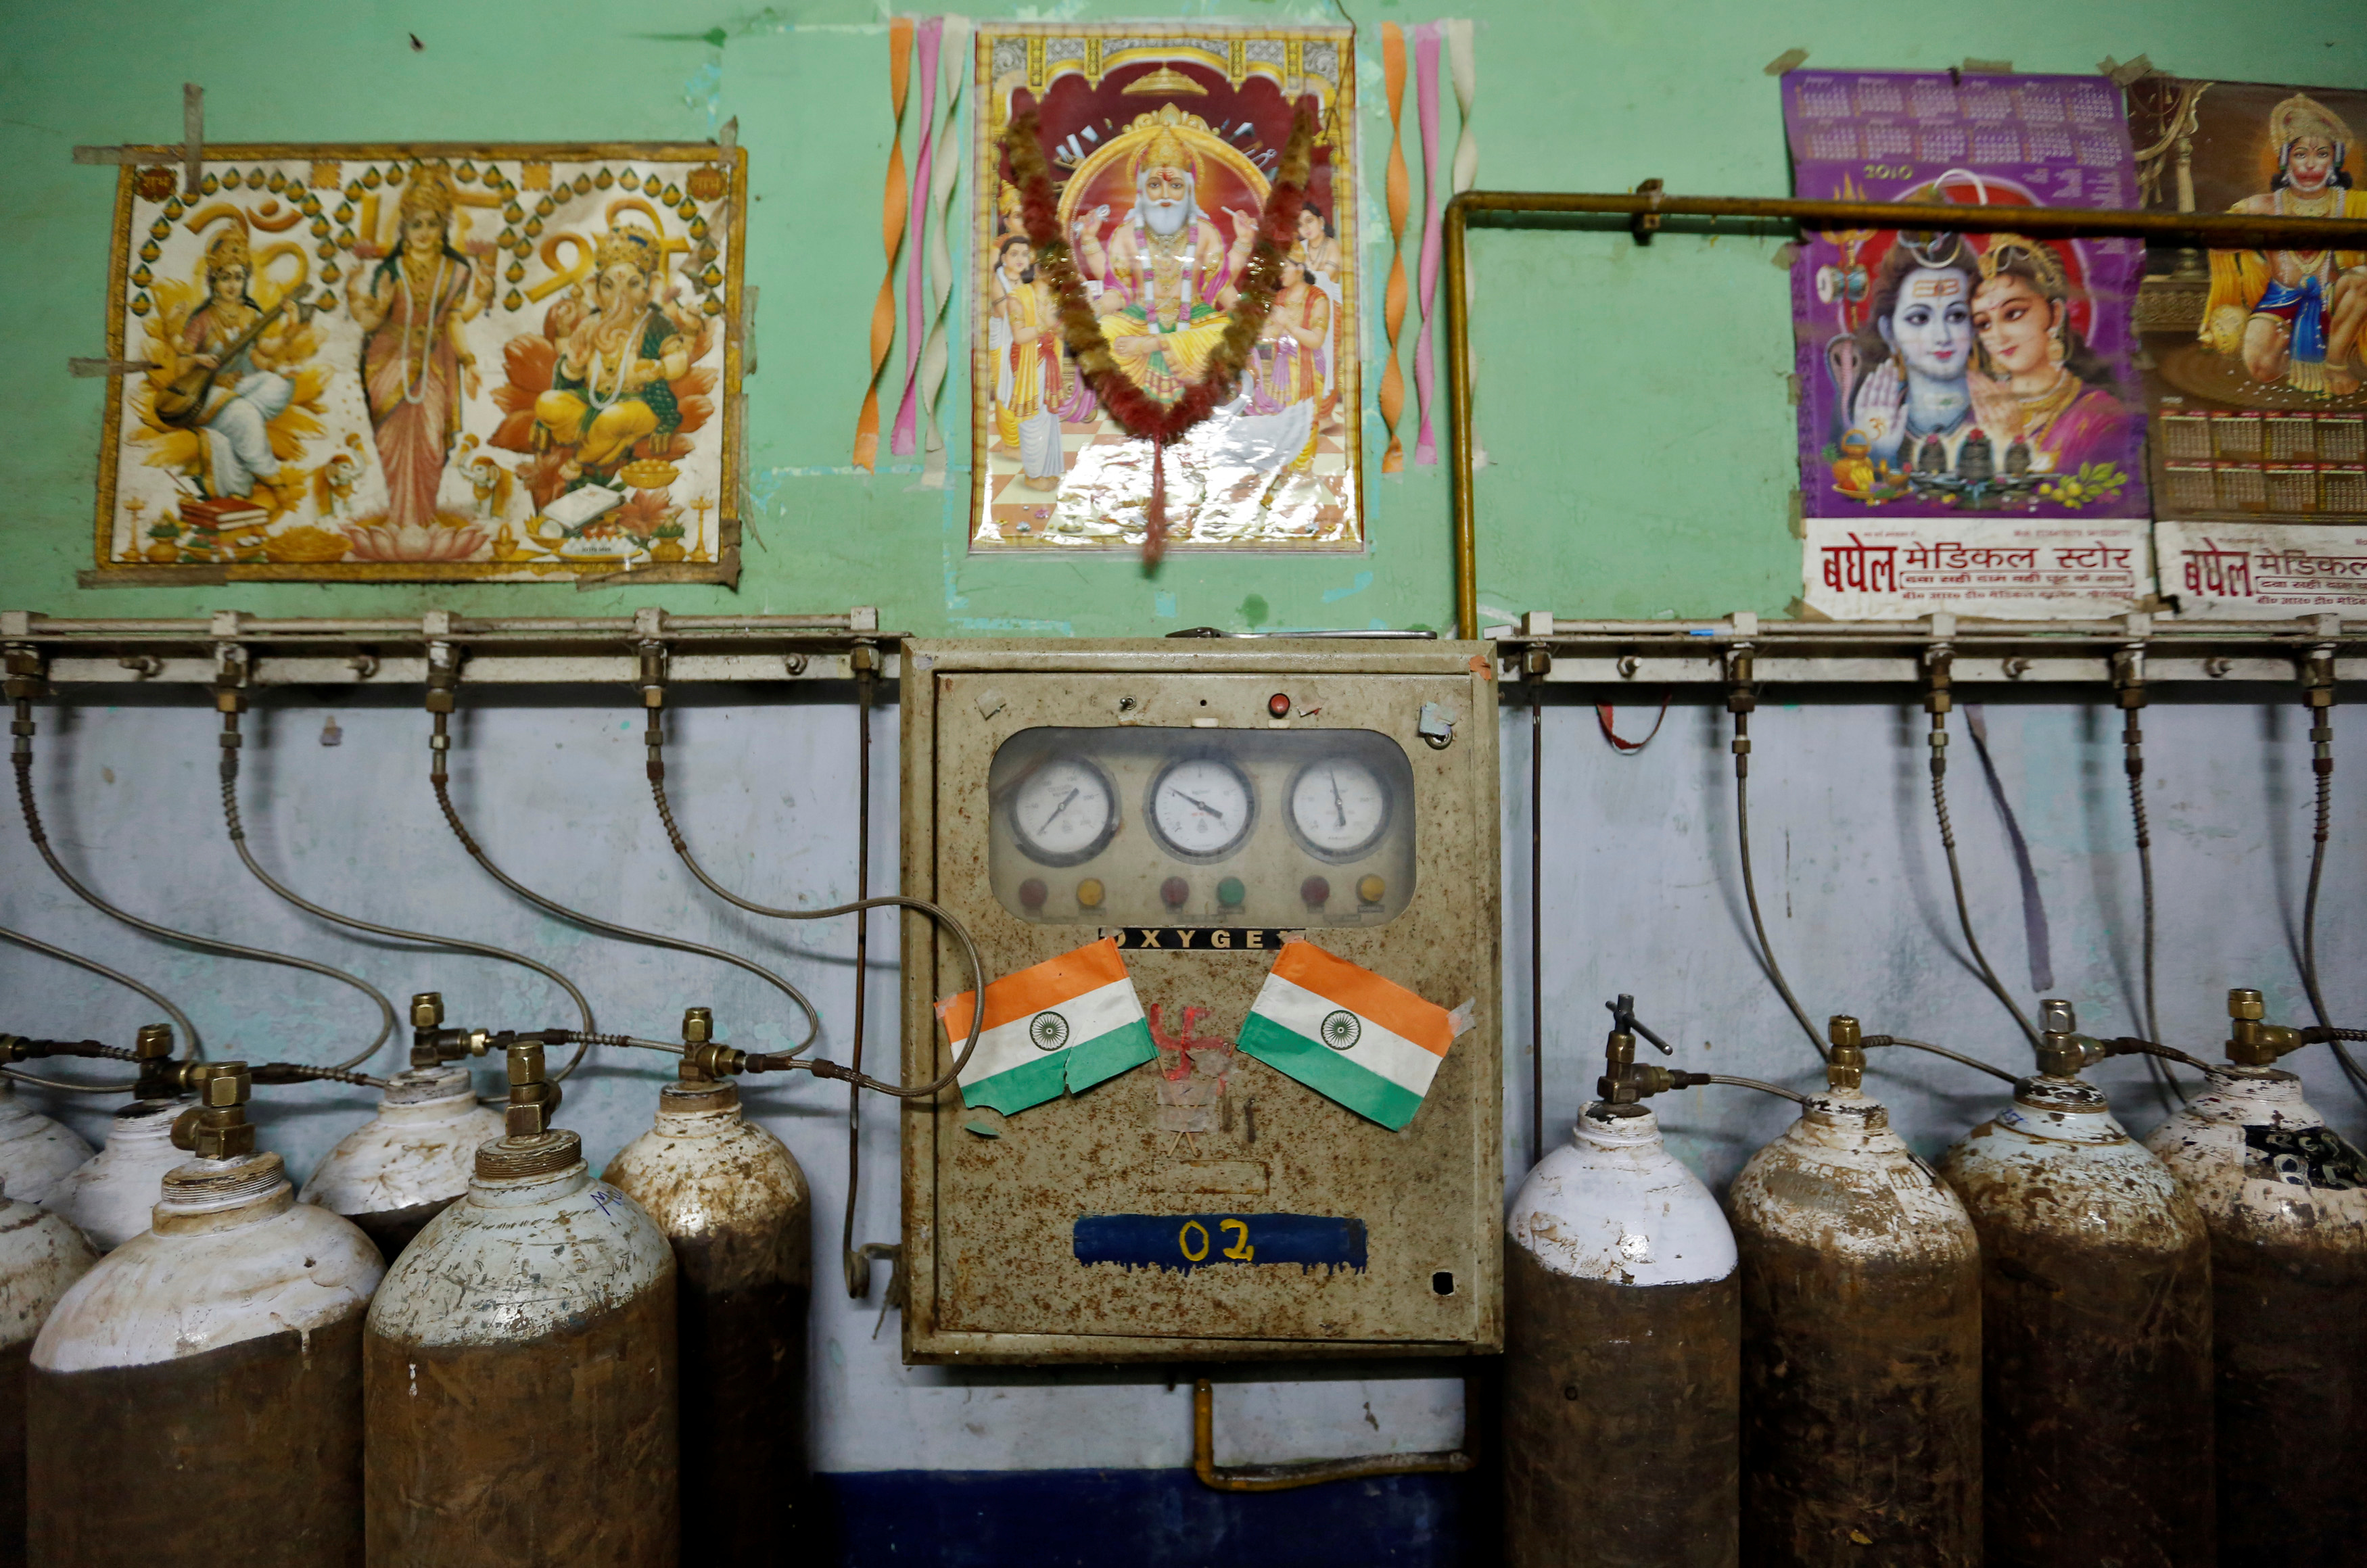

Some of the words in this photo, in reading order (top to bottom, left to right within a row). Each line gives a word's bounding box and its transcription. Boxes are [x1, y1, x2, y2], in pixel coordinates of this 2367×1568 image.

[1864, 164, 1913, 181] 2010
[1821, 531, 1898, 592] बघेल
[1903, 542, 2038, 569] मेडिकल
[2053, 540, 2133, 569] स्टोर
[2181, 537, 2253, 597] बघेल
[1115, 929, 1293, 949] XYGE
